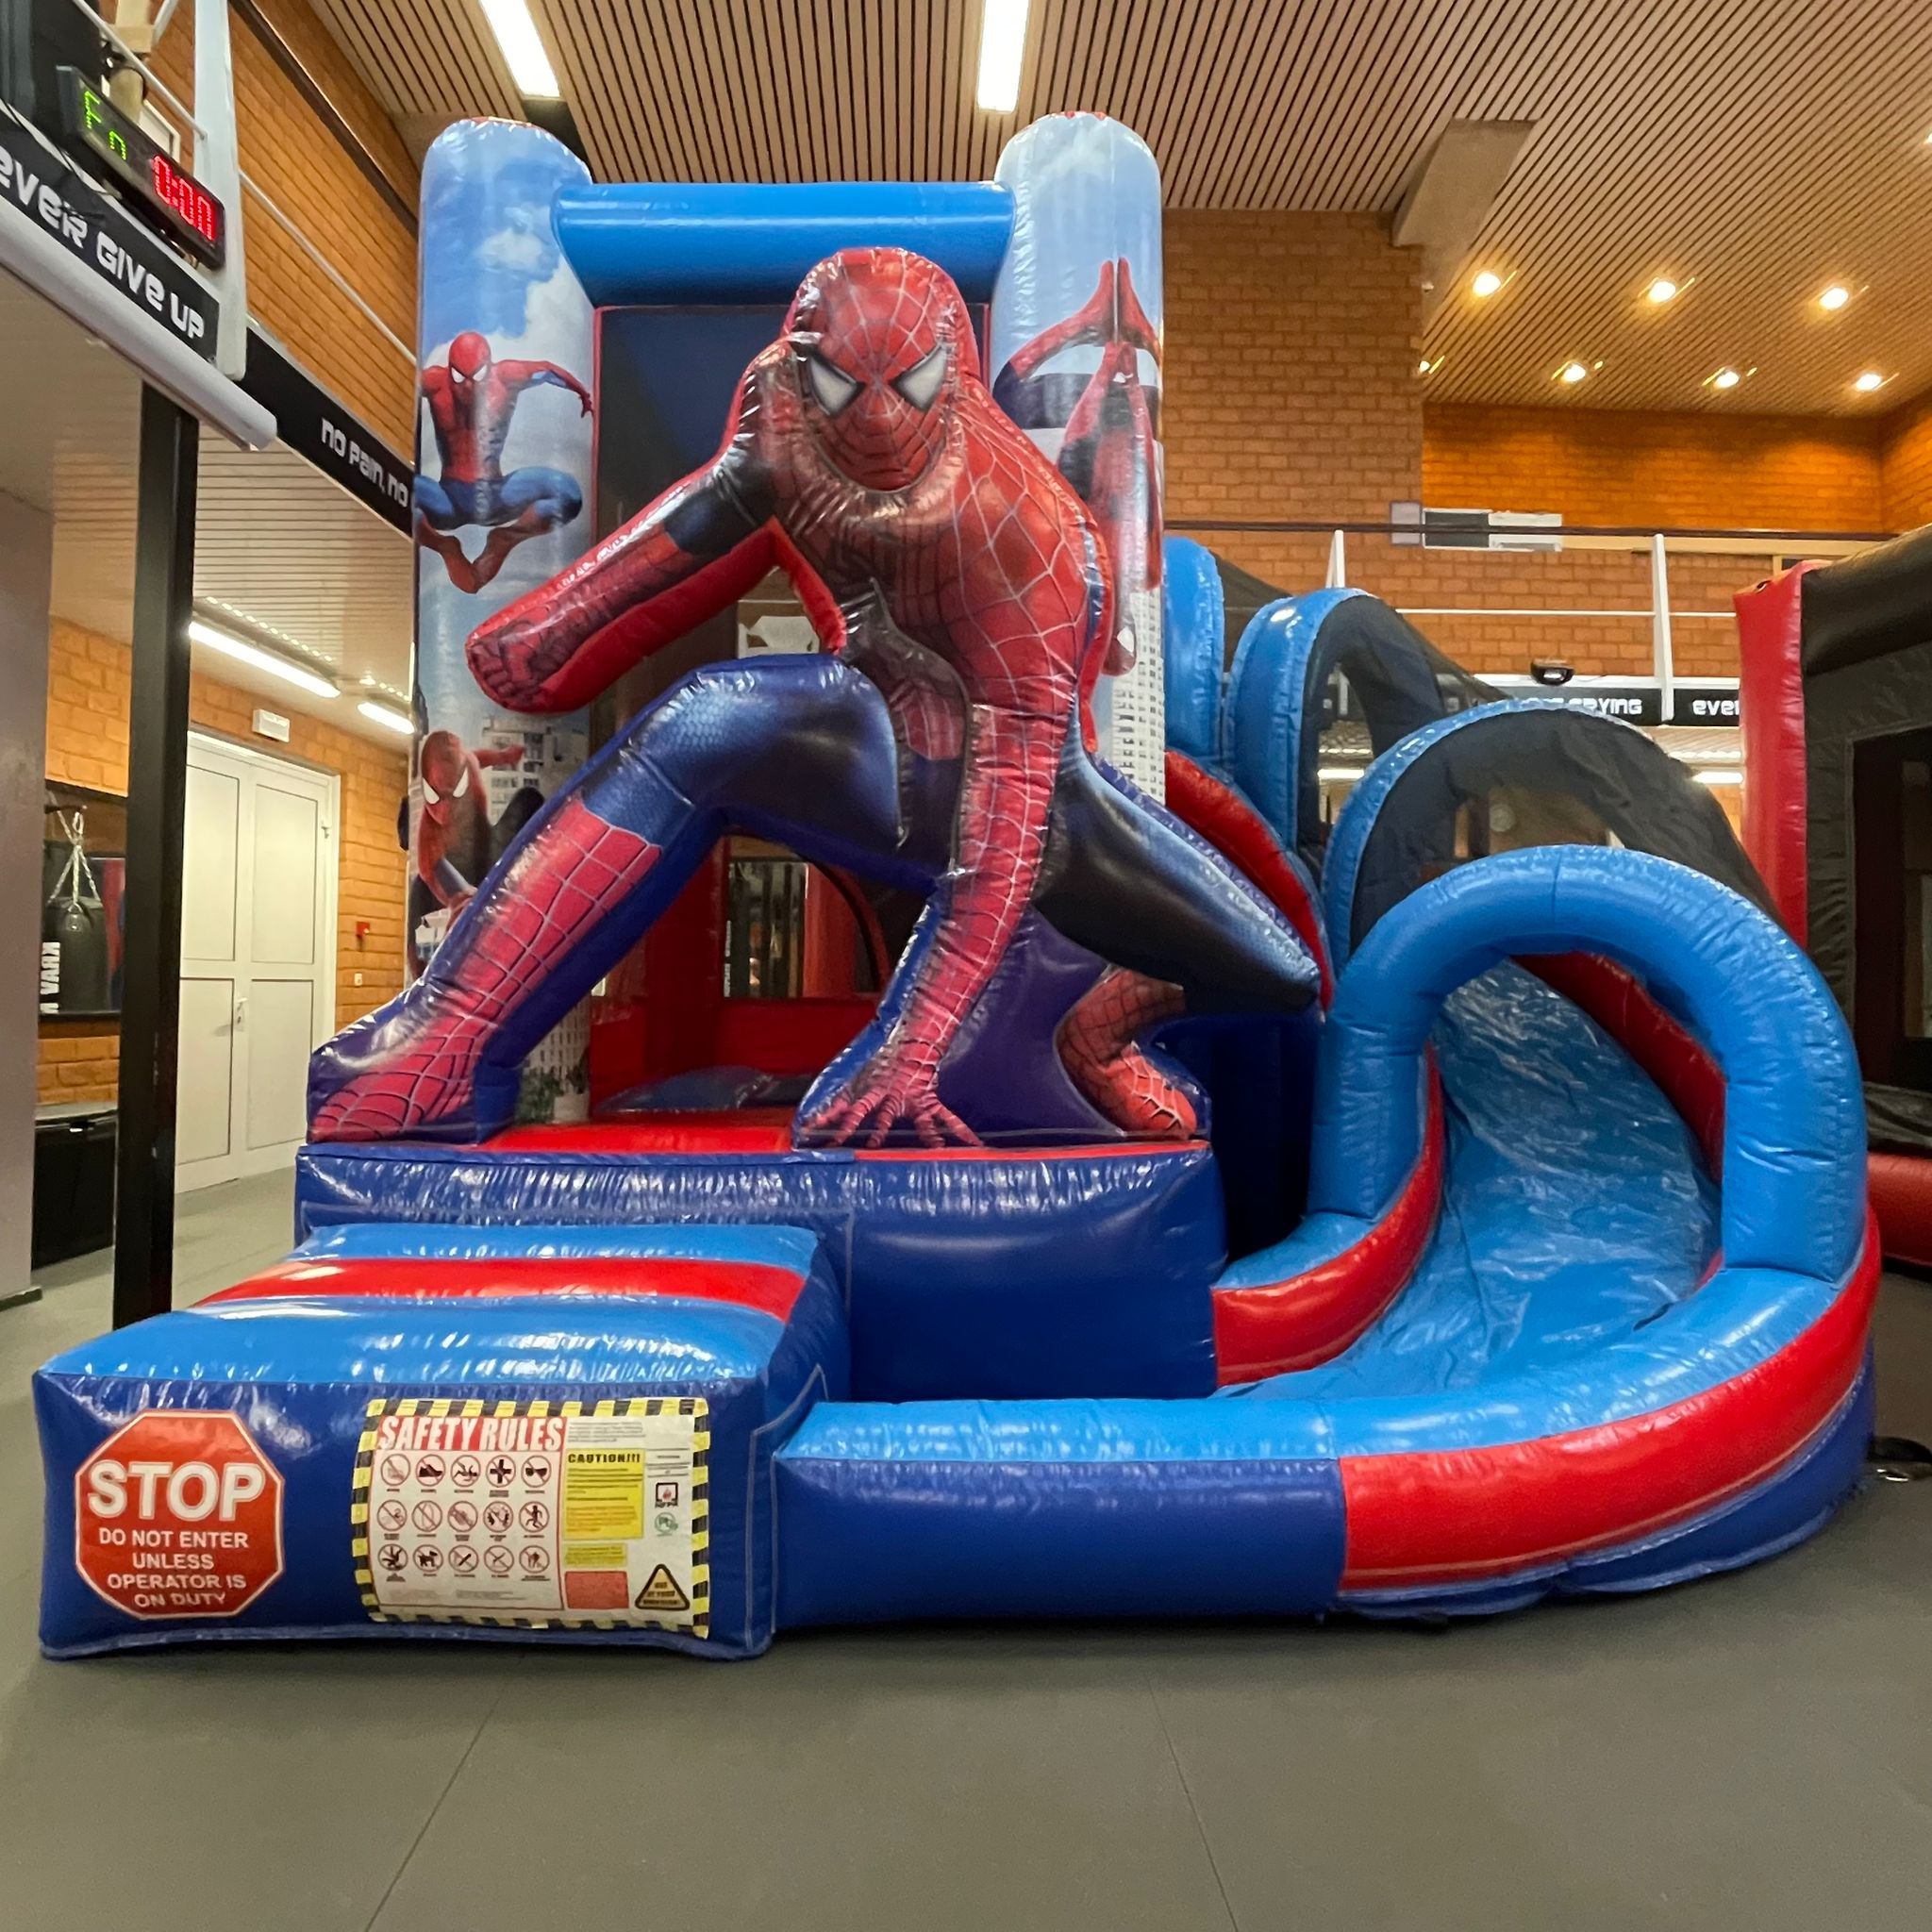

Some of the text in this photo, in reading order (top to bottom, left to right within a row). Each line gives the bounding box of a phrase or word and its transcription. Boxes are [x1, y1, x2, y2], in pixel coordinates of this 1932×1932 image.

[171, 292, 204, 339] UP
[379, 1416, 478, 1451] SAFETY
[478, 1417, 564, 1452] RULES
[567, 1453, 641, 1464] CAUTION!!!
[88, 1459, 265, 1522] STOP
[98, 1527, 249, 1548] DO NOT ENTER
[132, 1553, 215, 1570] UNLESS
[107, 1574, 247, 1590] OPERATOR IS
[134, 1592, 225, 1607] ON DUTY
